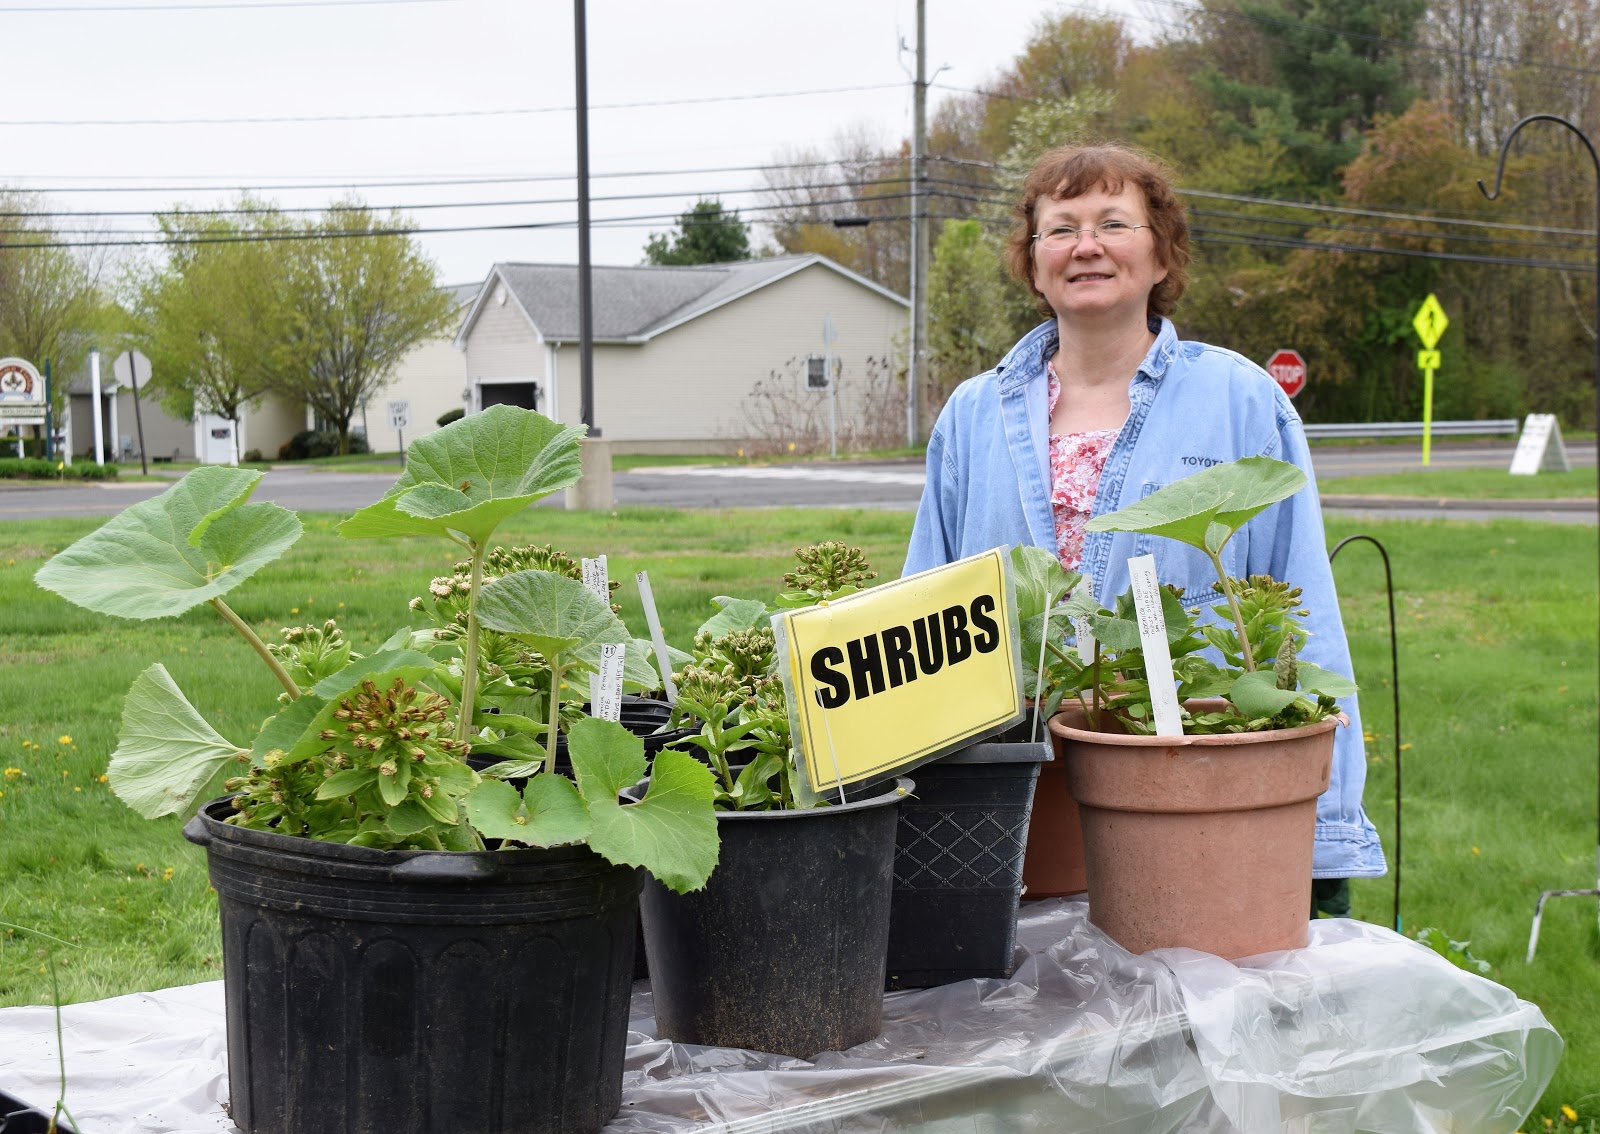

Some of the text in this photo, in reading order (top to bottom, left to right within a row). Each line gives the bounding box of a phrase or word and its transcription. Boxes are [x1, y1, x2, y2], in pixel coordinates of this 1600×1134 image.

[1271, 365, 1302, 383] STOP
[394, 416, 407, 427] 15
[1181, 456, 1224, 468] TOYOT
[810, 595, 999, 709] SHRUBS
